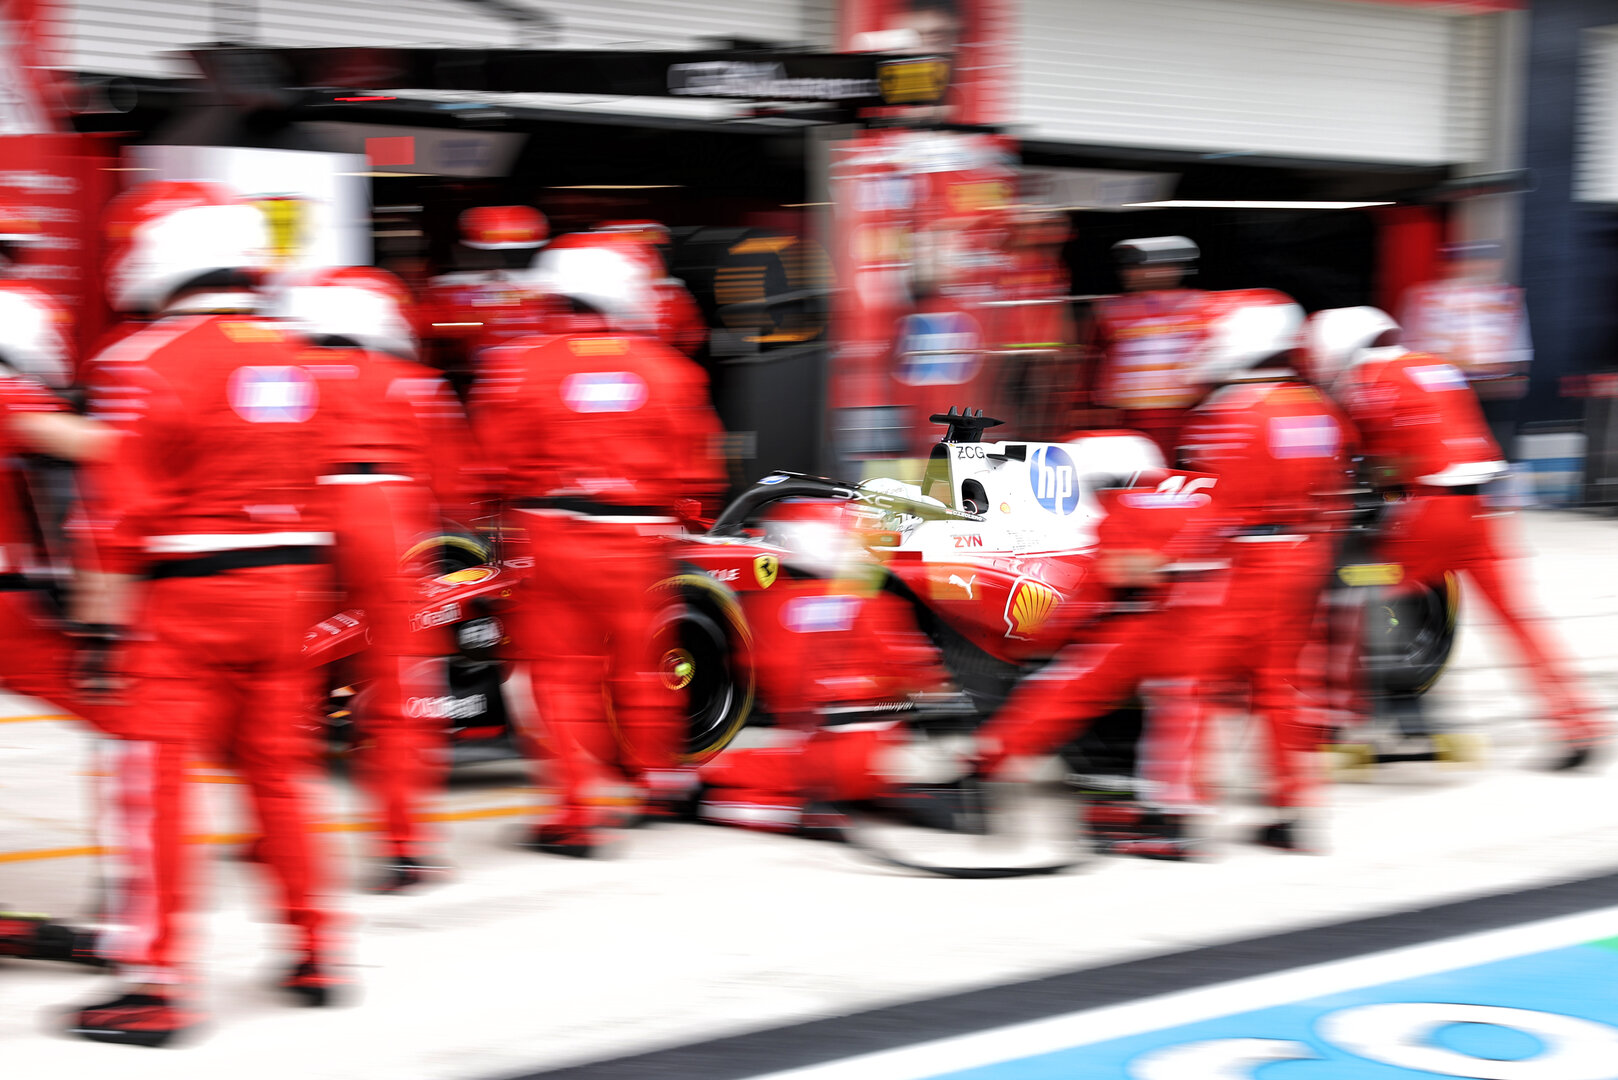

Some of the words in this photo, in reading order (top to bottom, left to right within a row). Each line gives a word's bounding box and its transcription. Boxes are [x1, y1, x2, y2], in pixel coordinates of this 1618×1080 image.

[955, 446, 985, 460] ZCG
[1036, 445, 1073, 516] hp
[832, 487, 895, 508] DXC
[953, 535, 983, 548] ZYN
